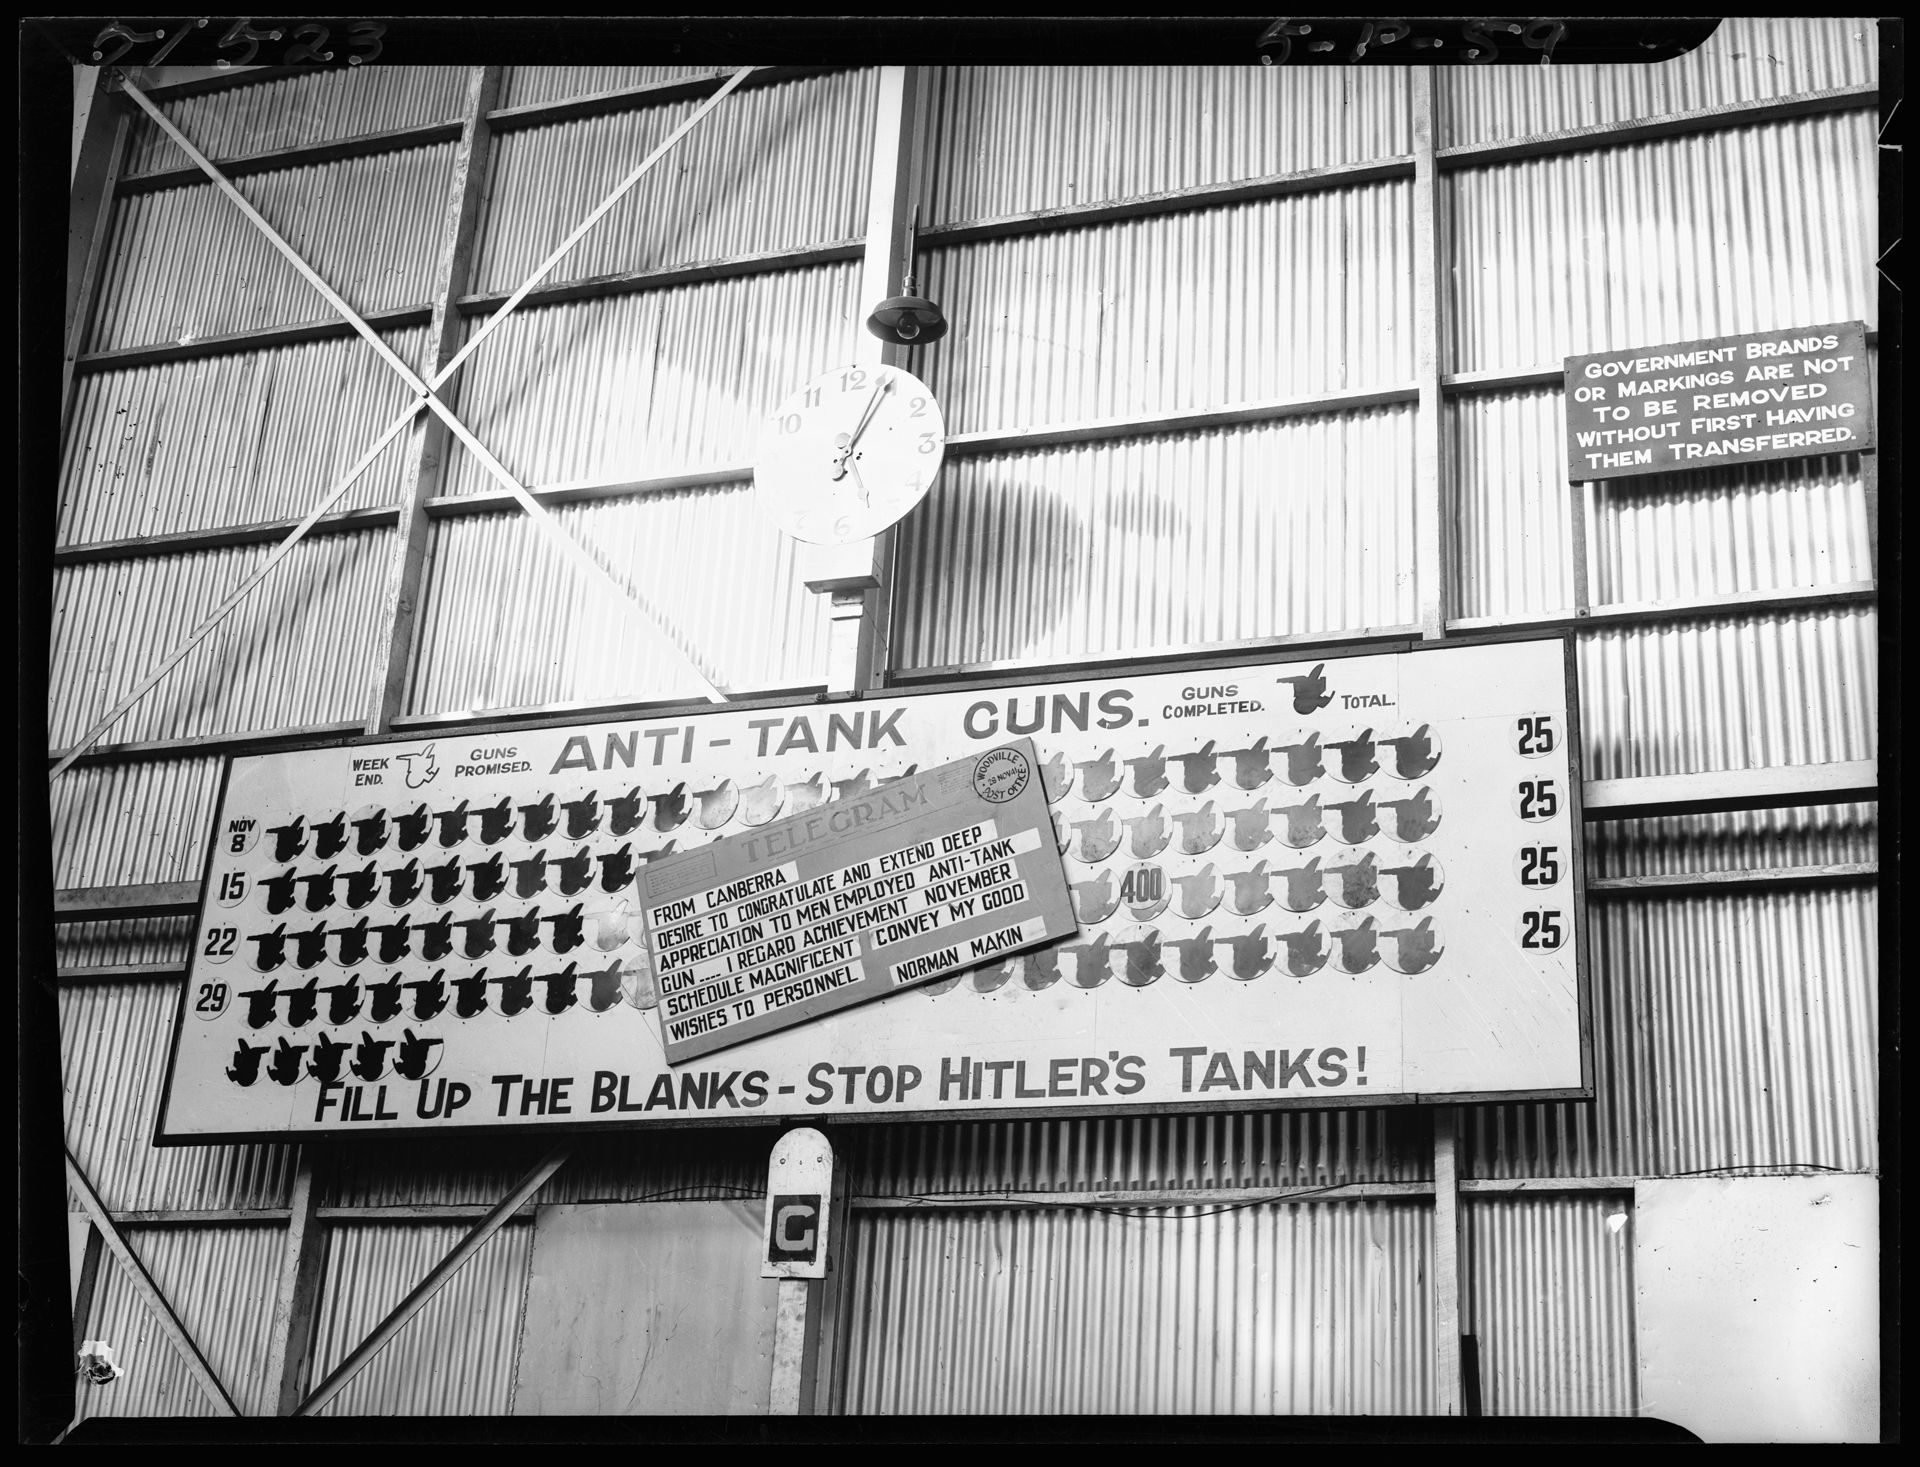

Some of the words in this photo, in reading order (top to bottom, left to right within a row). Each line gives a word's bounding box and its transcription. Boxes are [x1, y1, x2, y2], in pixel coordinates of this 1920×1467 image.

[1585, 347, 1737, 379] GOVERNMENT
[1746, 335, 1839, 360] BRANDS
[840, 370, 866, 392] 12
[1574, 386, 1606, 403] OR
[1618, 370, 1734, 398] MARKINGS
[1744, 363, 1794, 383] ARE
[1803, 356, 1854, 376] NOT
[803, 387, 821, 408] 11
[910, 397, 927, 418] 2
[1593, 406, 1630, 423] TO
[1644, 399, 1677, 418] BE
[1693, 383, 1828, 411] REMOVED
[778, 413, 802, 435] 10
[1576, 421, 1681, 448] WITHOUT
[1691, 413, 1757, 435] FIRST
[1766, 403, 1855, 426] HAVING
[918, 432, 936, 454] 3
[1585, 449, 1652, 470] THEM
[1668, 427, 1857, 460] TRANSFERRED.
[905, 470, 923, 491] 4
[833, 515, 850, 536] 6
[1181, 683, 1239, 700] GUNS
[1341, 694, 1396, 709] TOTAL.
[1161, 698, 1265, 719] COMPLETED.
[549, 726, 695, 775] ANTI
[747, 707, 908, 758] TANK
[962, 690, 1149, 740] GUNS.
[1517, 717, 1553, 755] 25
[353, 757, 390, 772] WEEK
[454, 760, 533, 778] PROMISED.
[470, 746, 518, 762] GUNS
[977, 751, 1019, 781] WOODVILLE
[354, 774, 384, 787] END.
[1007, 768, 1026, 796] OFFICE
[1519, 781, 1557, 819] 25
[228, 819, 256, 833] NOV
[741, 783, 930, 863] TELEGRAM
[230, 834, 246, 852] 8
[1520, 846, 1559, 885] 25
[219, 872, 245, 900] 15
[653, 898, 696, 926] FROM
[706, 868, 787, 909] CANBERRA
[657, 920, 704, 950] DESIRE
[708, 912, 729, 932] TO
[737, 874, 837, 923] CONGRATULATE
[842, 862, 871, 887] AND
[880, 841, 935, 874] EXTEND
[941, 825, 982, 851] DEEP
[1121, 865, 1162, 903] 400
[660, 922, 764, 972] APPRECIATION
[769, 913, 792, 933] TO
[796, 898, 831, 926] MEN
[835, 872, 915, 912] EMPLOYED
[929, 838, 1015, 882] ANTI-TANK
[726, 956, 733, 973] I
[737, 935, 796, 970] REGARD
[803, 897, 908, 947] ACHIEVEMENT
[924, 862, 1012, 905] NOVEMBER
[204, 928, 237, 956] 22
[1521, 910, 1562, 949] 25
[667, 975, 745, 1016] SCHEDULE
[749, 940, 854, 989] MAGNIFICENT
[875, 910, 940, 946] CONVEY
[949, 898, 975, 921] MY
[981, 883, 1025, 911] GOOD
[896, 947, 960, 983] NORMAN
[970, 926, 1024, 958] MAKIN
[196, 983, 227, 1012] 29
[670, 1008, 728, 1041] WISHES
[732, 1000, 755, 1020] TO
[763, 966, 859, 1011] PERSONNEL
[314, 1081, 399, 1122] FILL
[416, 1077, 471, 1119] UP
[491, 1073, 574, 1118] THE
[589, 1069, 769, 1114] BLANKS
[805, 1061, 922, 1105] STOP
[939, 1050, 1147, 1101] HITLER'S
[1169, 1046, 1368, 1093] TANKS!
